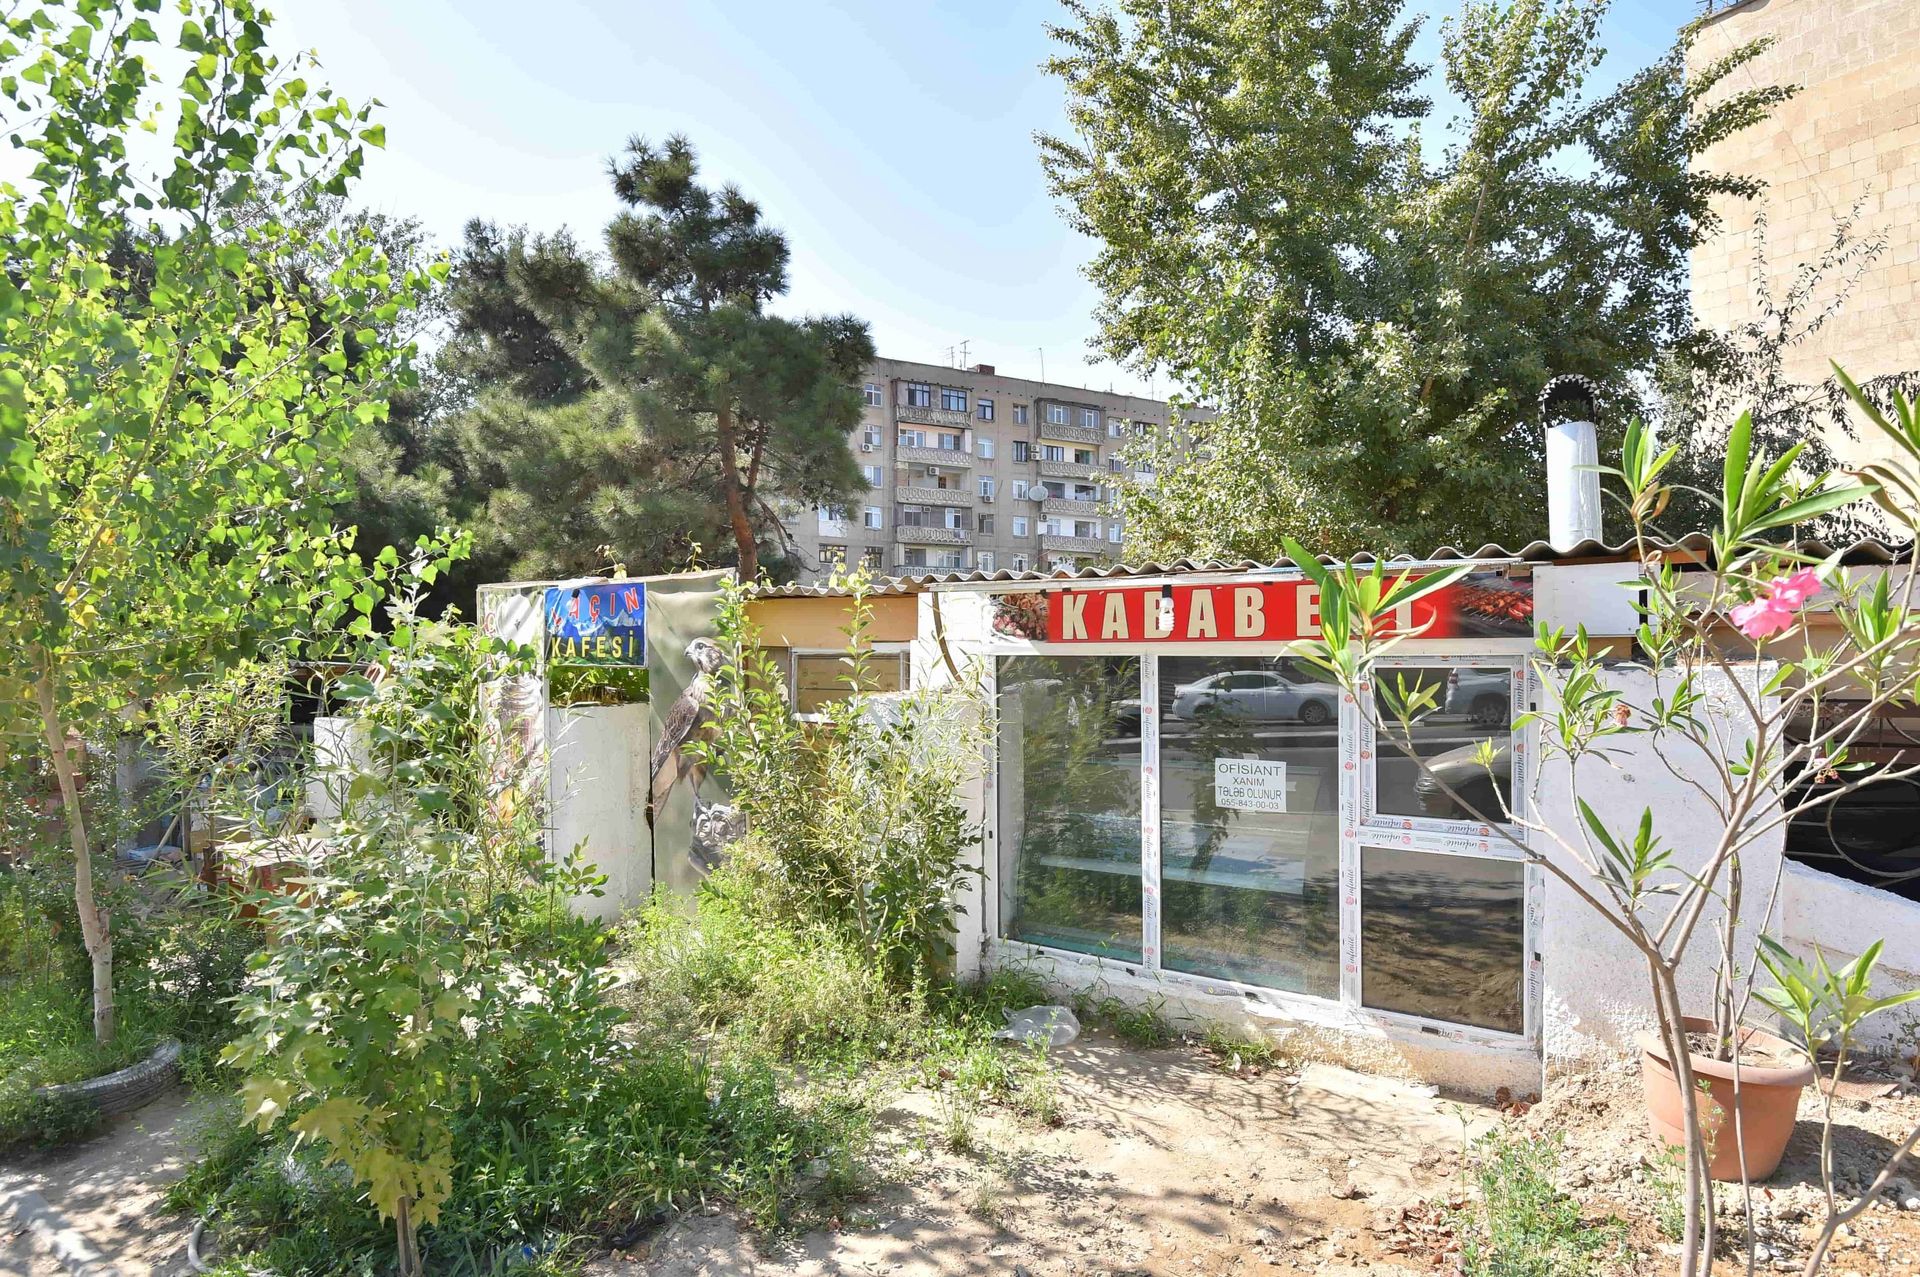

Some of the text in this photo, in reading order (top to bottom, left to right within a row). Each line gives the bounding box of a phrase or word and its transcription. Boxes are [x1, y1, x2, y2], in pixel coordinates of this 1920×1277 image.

[1062, 586, 1266, 641] KABAB
[551, 630, 634, 658] KAFESİ
[1218, 762, 1282, 776] OFİSİANT
[1232, 776, 1265, 787] XANIM
[1217, 786, 1282, 800] TƏLƏB OLUNUR
[1220, 798, 1279, 810] 055-843-00-03
